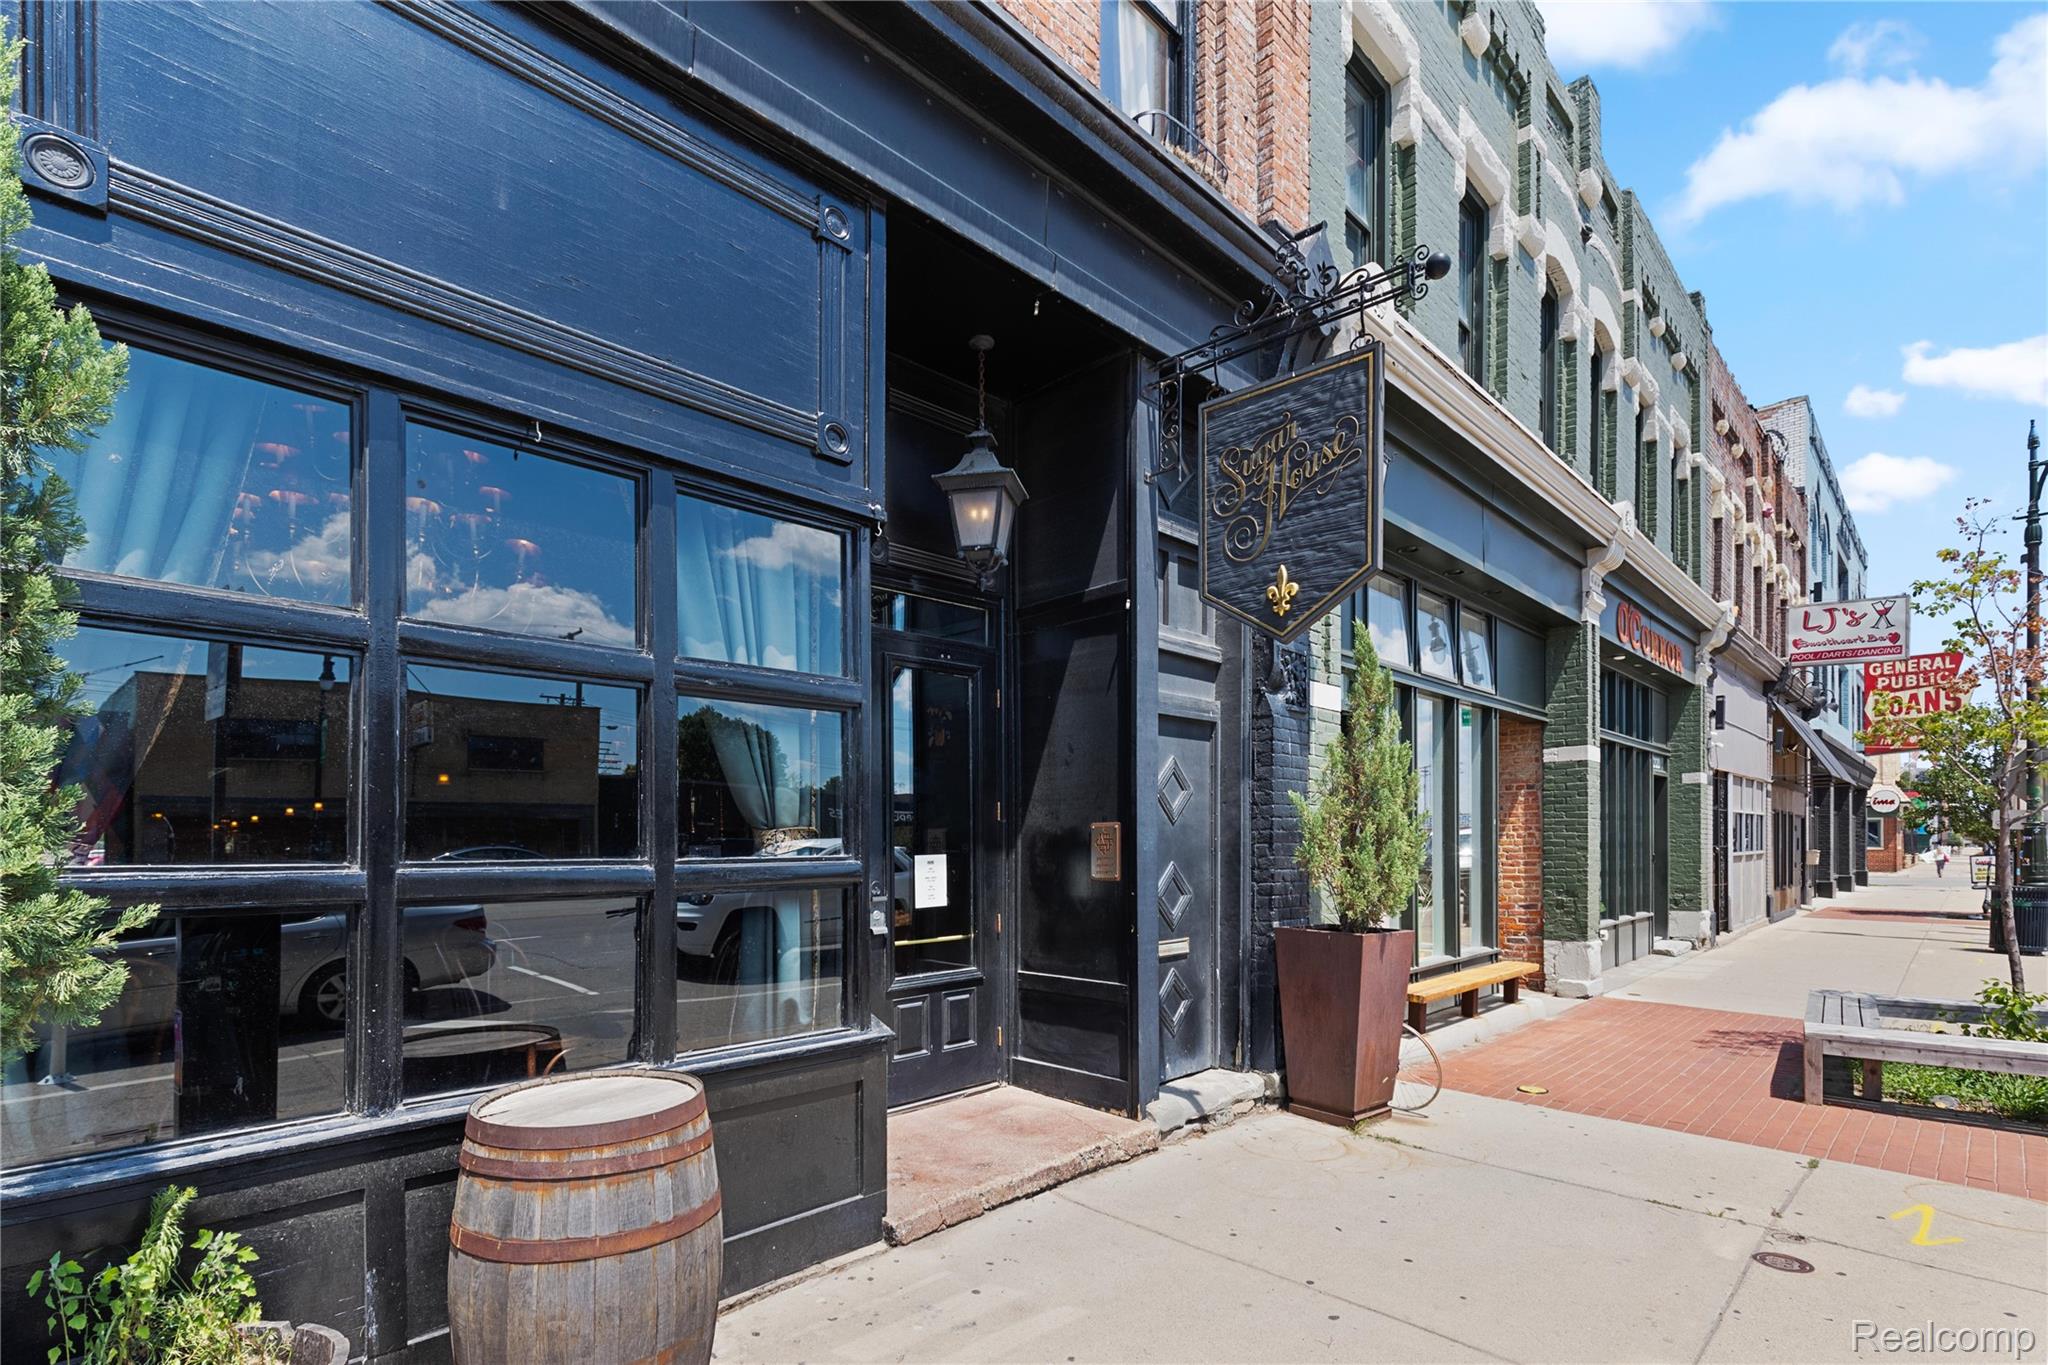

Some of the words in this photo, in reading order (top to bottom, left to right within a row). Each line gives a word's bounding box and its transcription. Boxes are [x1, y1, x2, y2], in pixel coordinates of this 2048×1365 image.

[1213, 411, 1298, 517] Sugar
[1802, 607, 1868, 635] LJ's
[1799, 636, 1866, 648] Sweetheart
[1868, 656, 1956, 676] GENERAL
[1877, 671, 1950, 690] PUBLIC
[1889, 1203, 1965, 1246] 2
